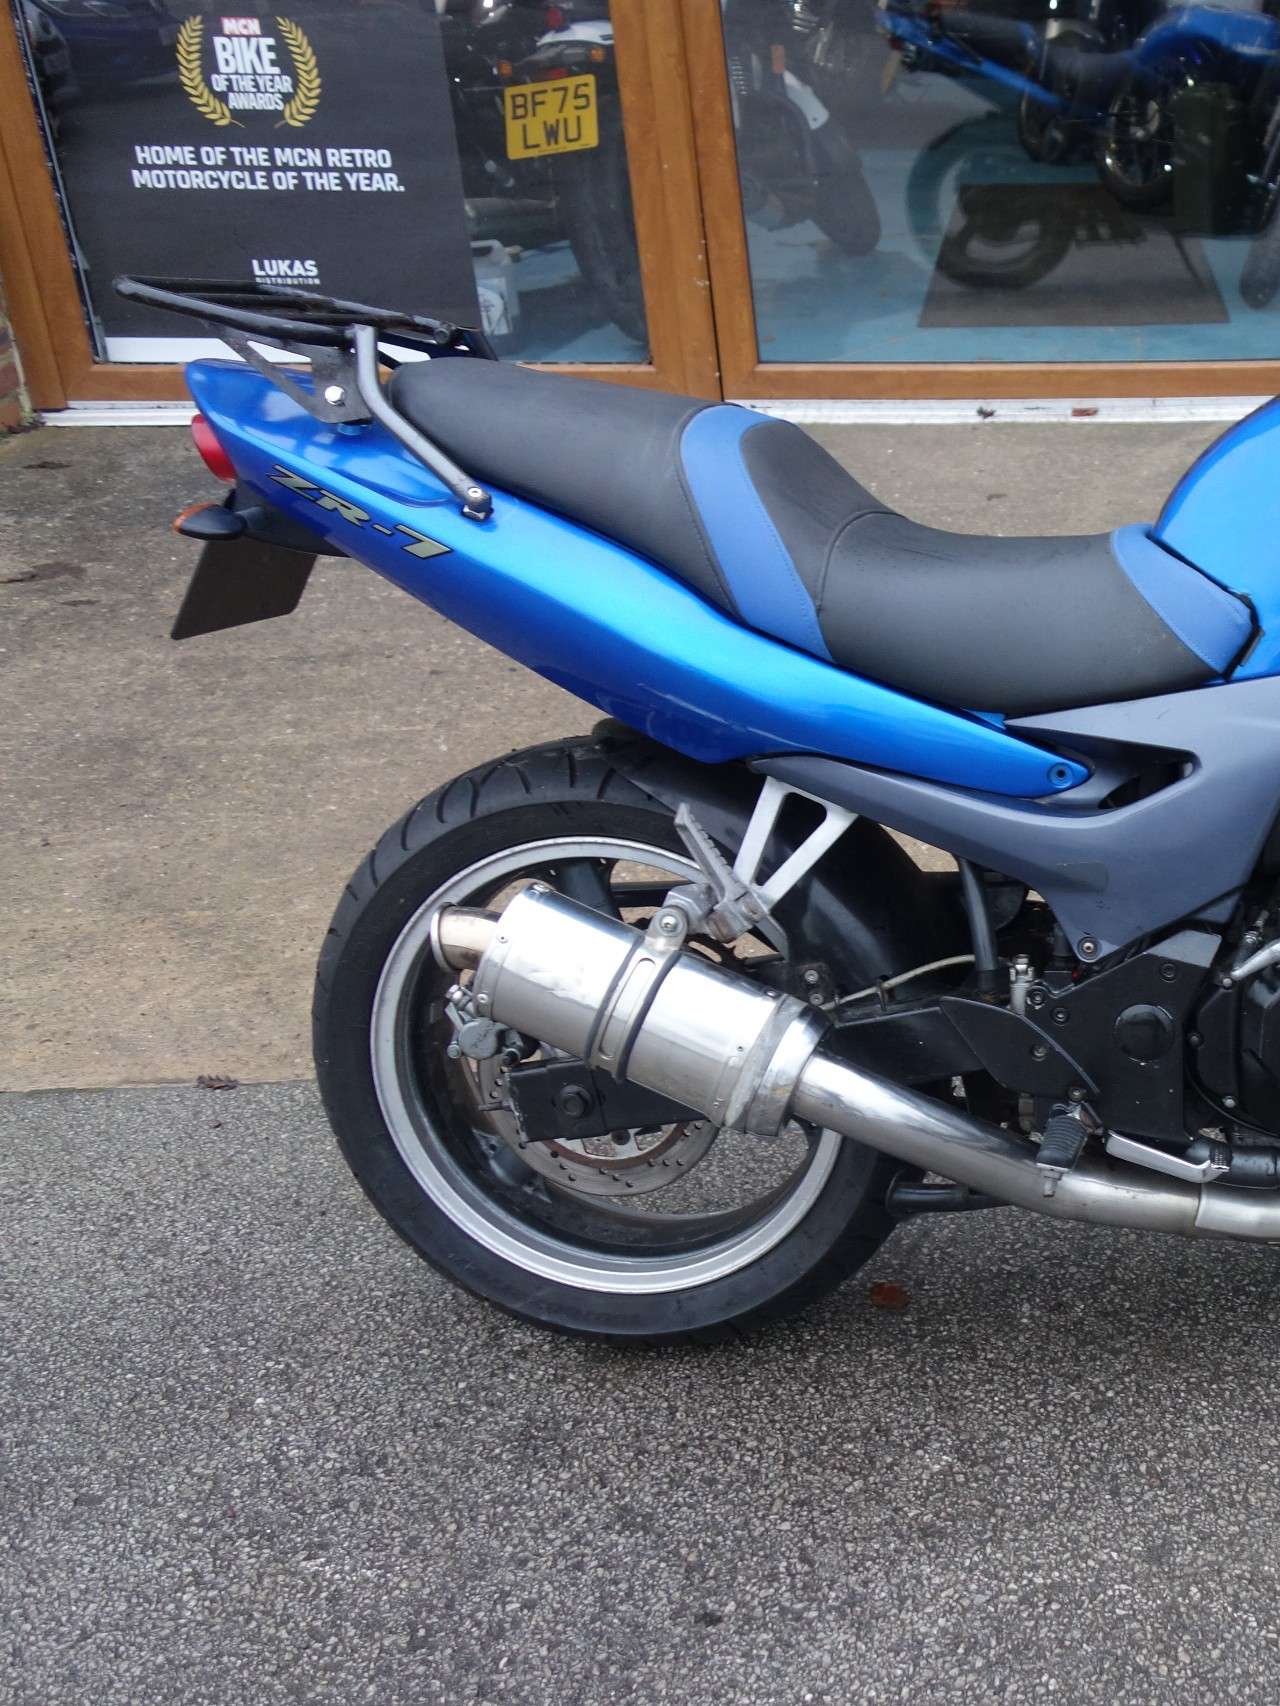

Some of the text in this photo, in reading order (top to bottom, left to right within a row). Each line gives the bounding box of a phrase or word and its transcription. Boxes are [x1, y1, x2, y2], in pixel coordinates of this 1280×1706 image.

[221, 18, 261, 35] MCN
[212, 36, 281, 74] BIKE
[210, 75, 294, 92] OF THE YEAR
[227, 92, 285, 110] AWARDS
[511, 83, 590, 119] BF75
[523, 115, 581, 150] LWU
[134, 146, 392, 168] HOME OF THE MCN RETRO
[131, 169, 405, 193] MOTORCYCLE OF THE YEAR.
[252, 259, 319, 276] LUKAS
[267, 464, 453, 559] ZR-7
